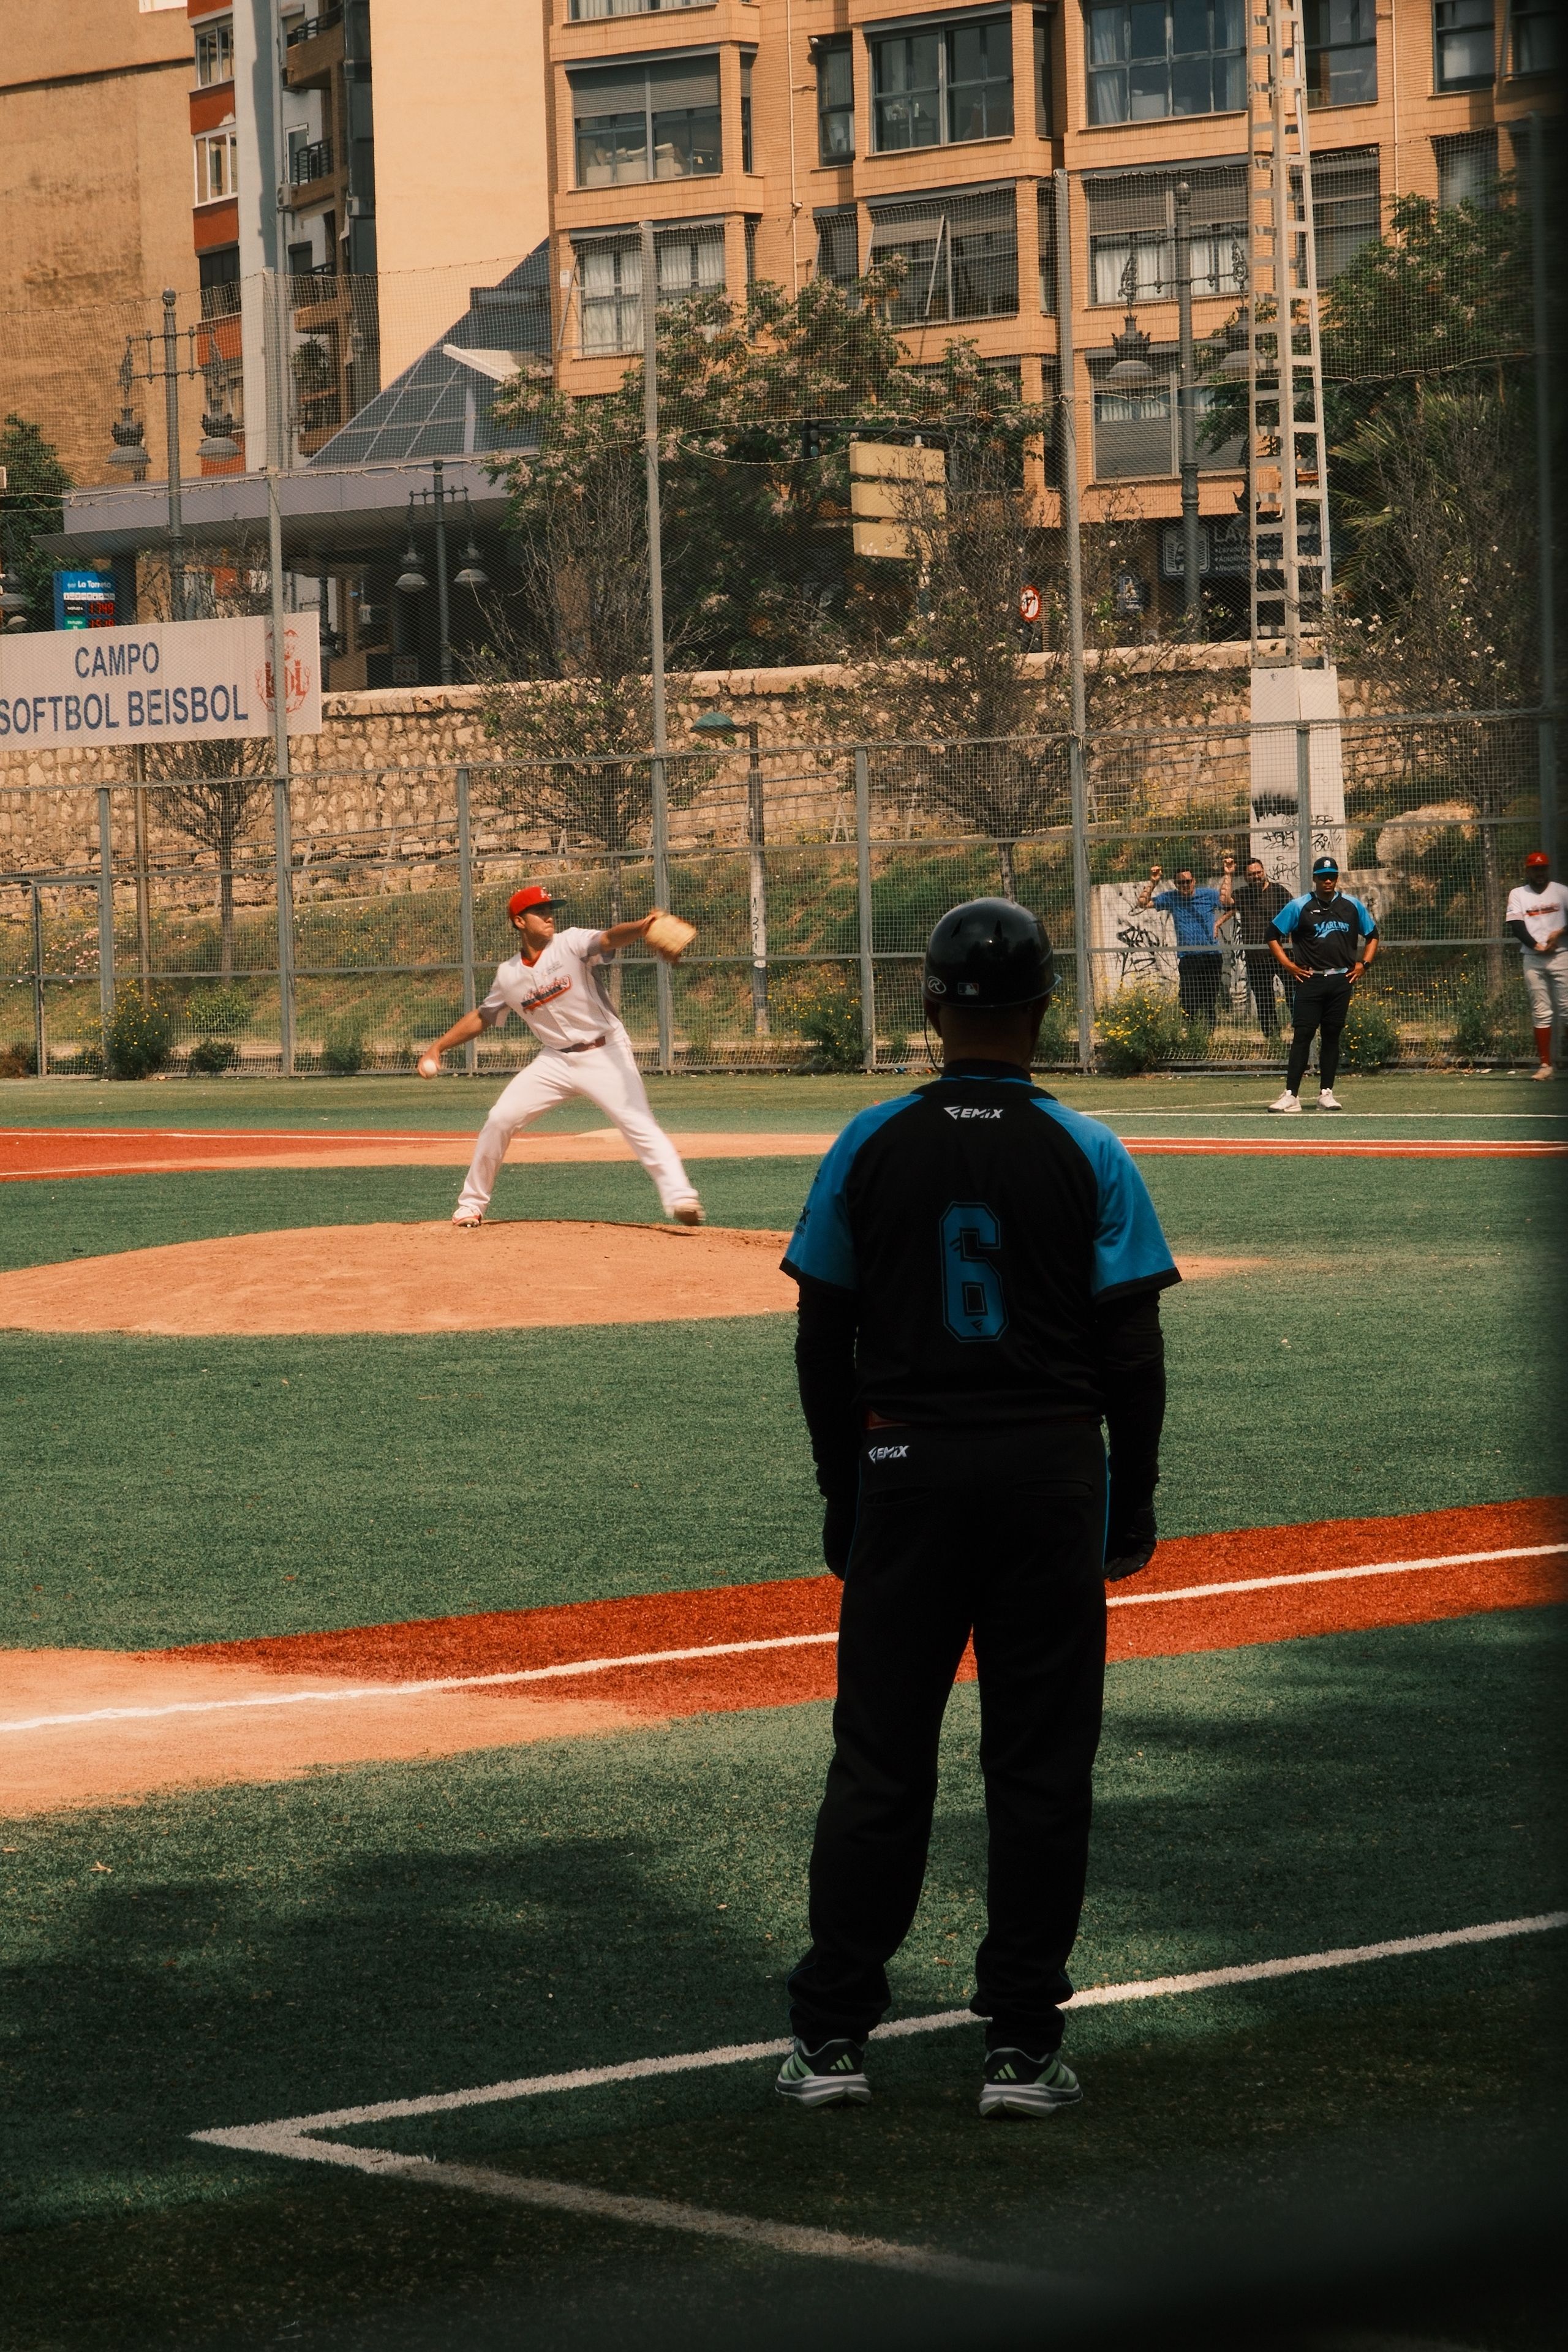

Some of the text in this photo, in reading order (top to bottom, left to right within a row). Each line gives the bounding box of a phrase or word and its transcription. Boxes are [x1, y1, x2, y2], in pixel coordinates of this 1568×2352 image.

[75, 641, 160, 679] CAMPO
[0, 684, 249, 735] SOFTBOL BEISBOL
[939, 1200, 1009, 1343] 6
